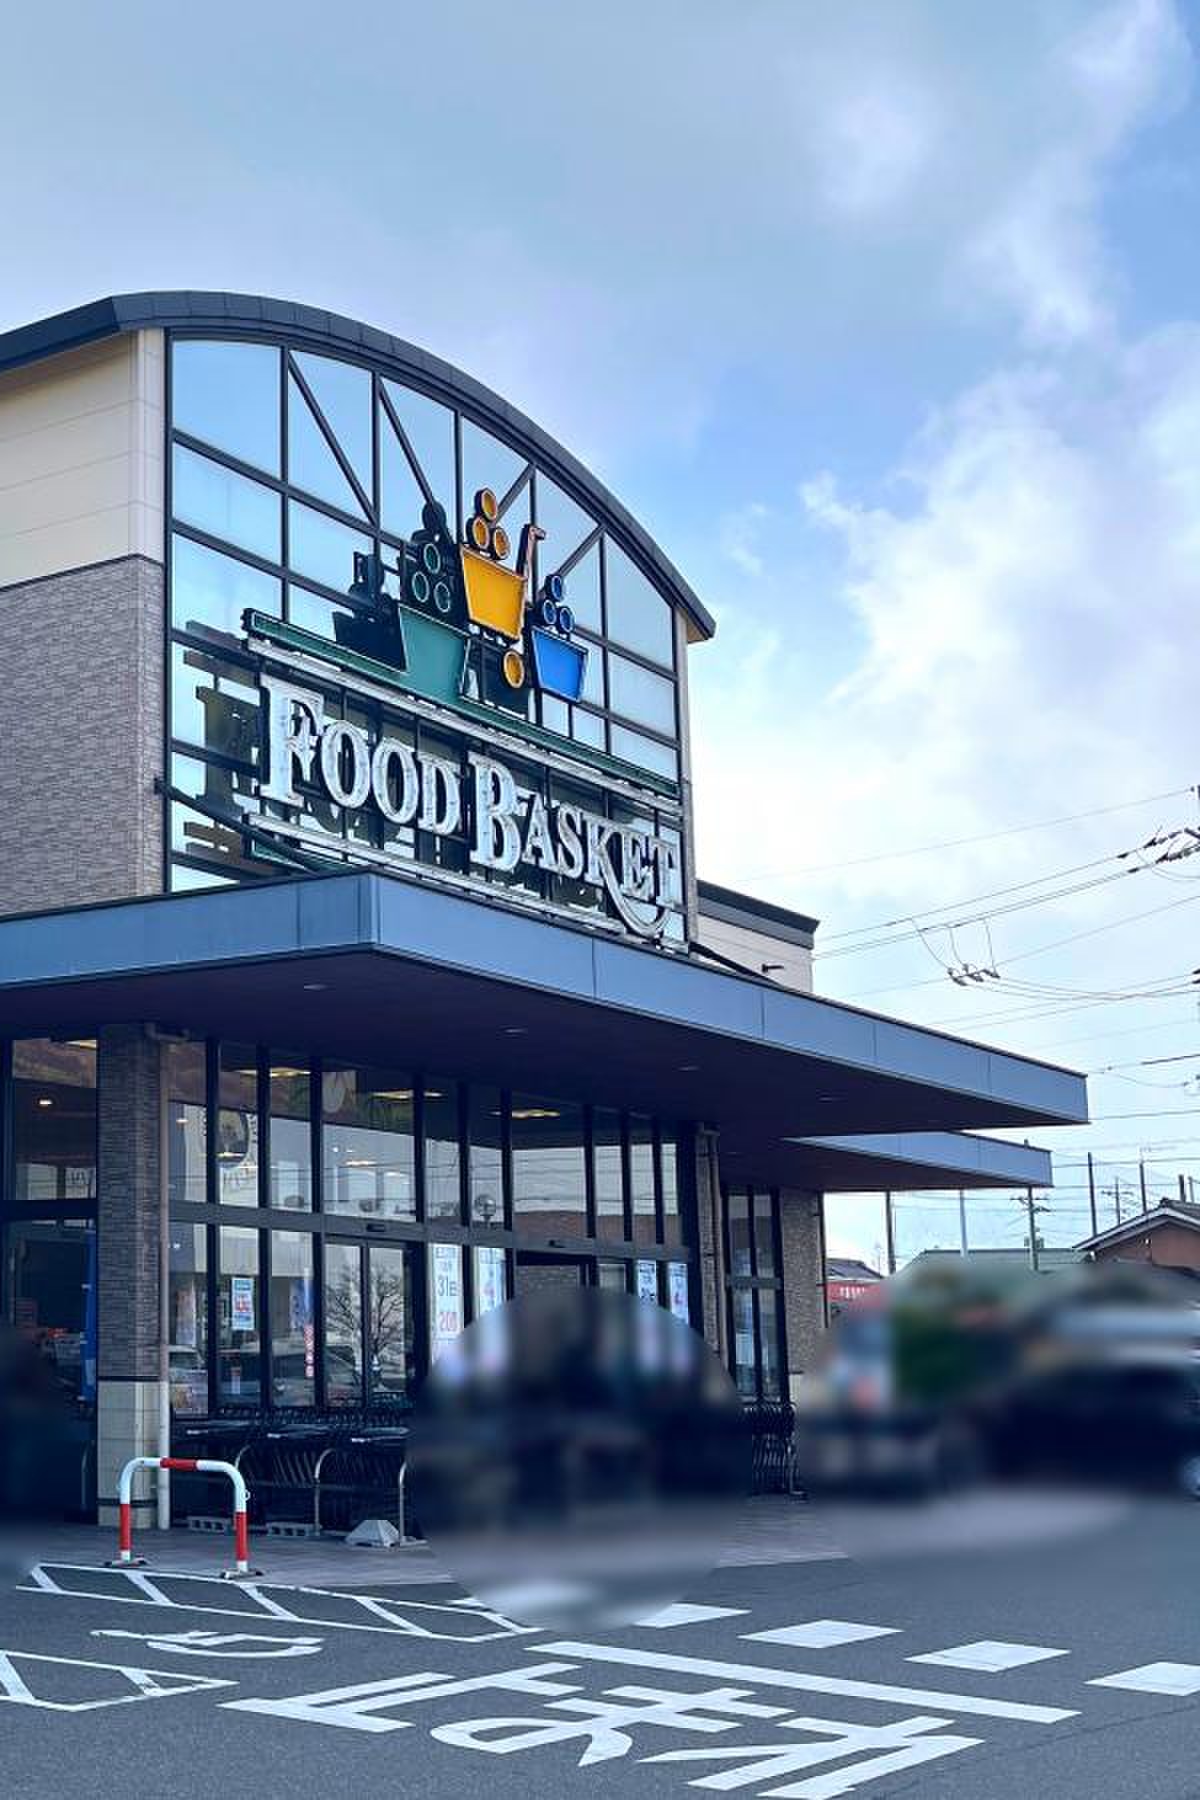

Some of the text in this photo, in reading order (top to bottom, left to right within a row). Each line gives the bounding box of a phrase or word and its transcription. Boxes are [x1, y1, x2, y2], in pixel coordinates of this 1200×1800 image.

[259, 672, 684, 937] FOOD BASKET
[215, 1662, 987, 1800] 止まれ
